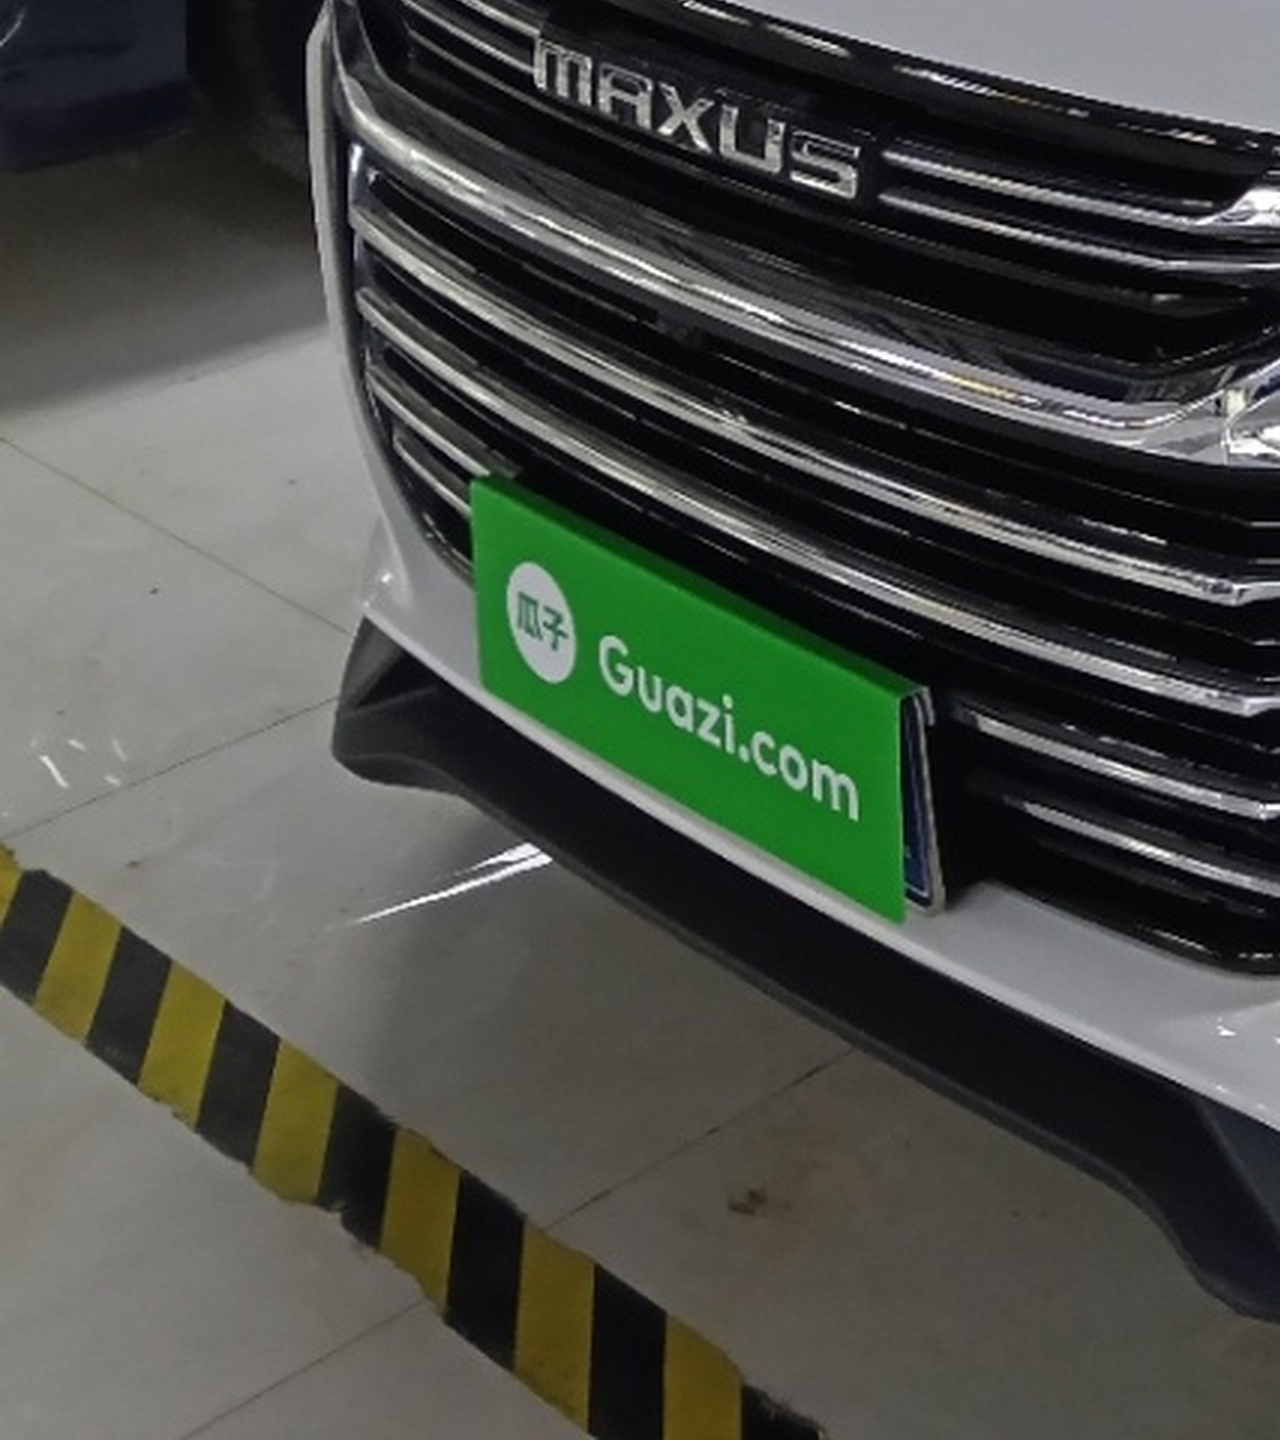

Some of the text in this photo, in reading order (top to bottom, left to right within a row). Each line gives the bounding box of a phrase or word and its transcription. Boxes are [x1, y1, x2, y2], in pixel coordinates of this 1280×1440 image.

[534, 37, 860, 200] MAXUS
[516, 592, 568, 651] 瓜子
[599, 635, 859, 821] Guazi.com
